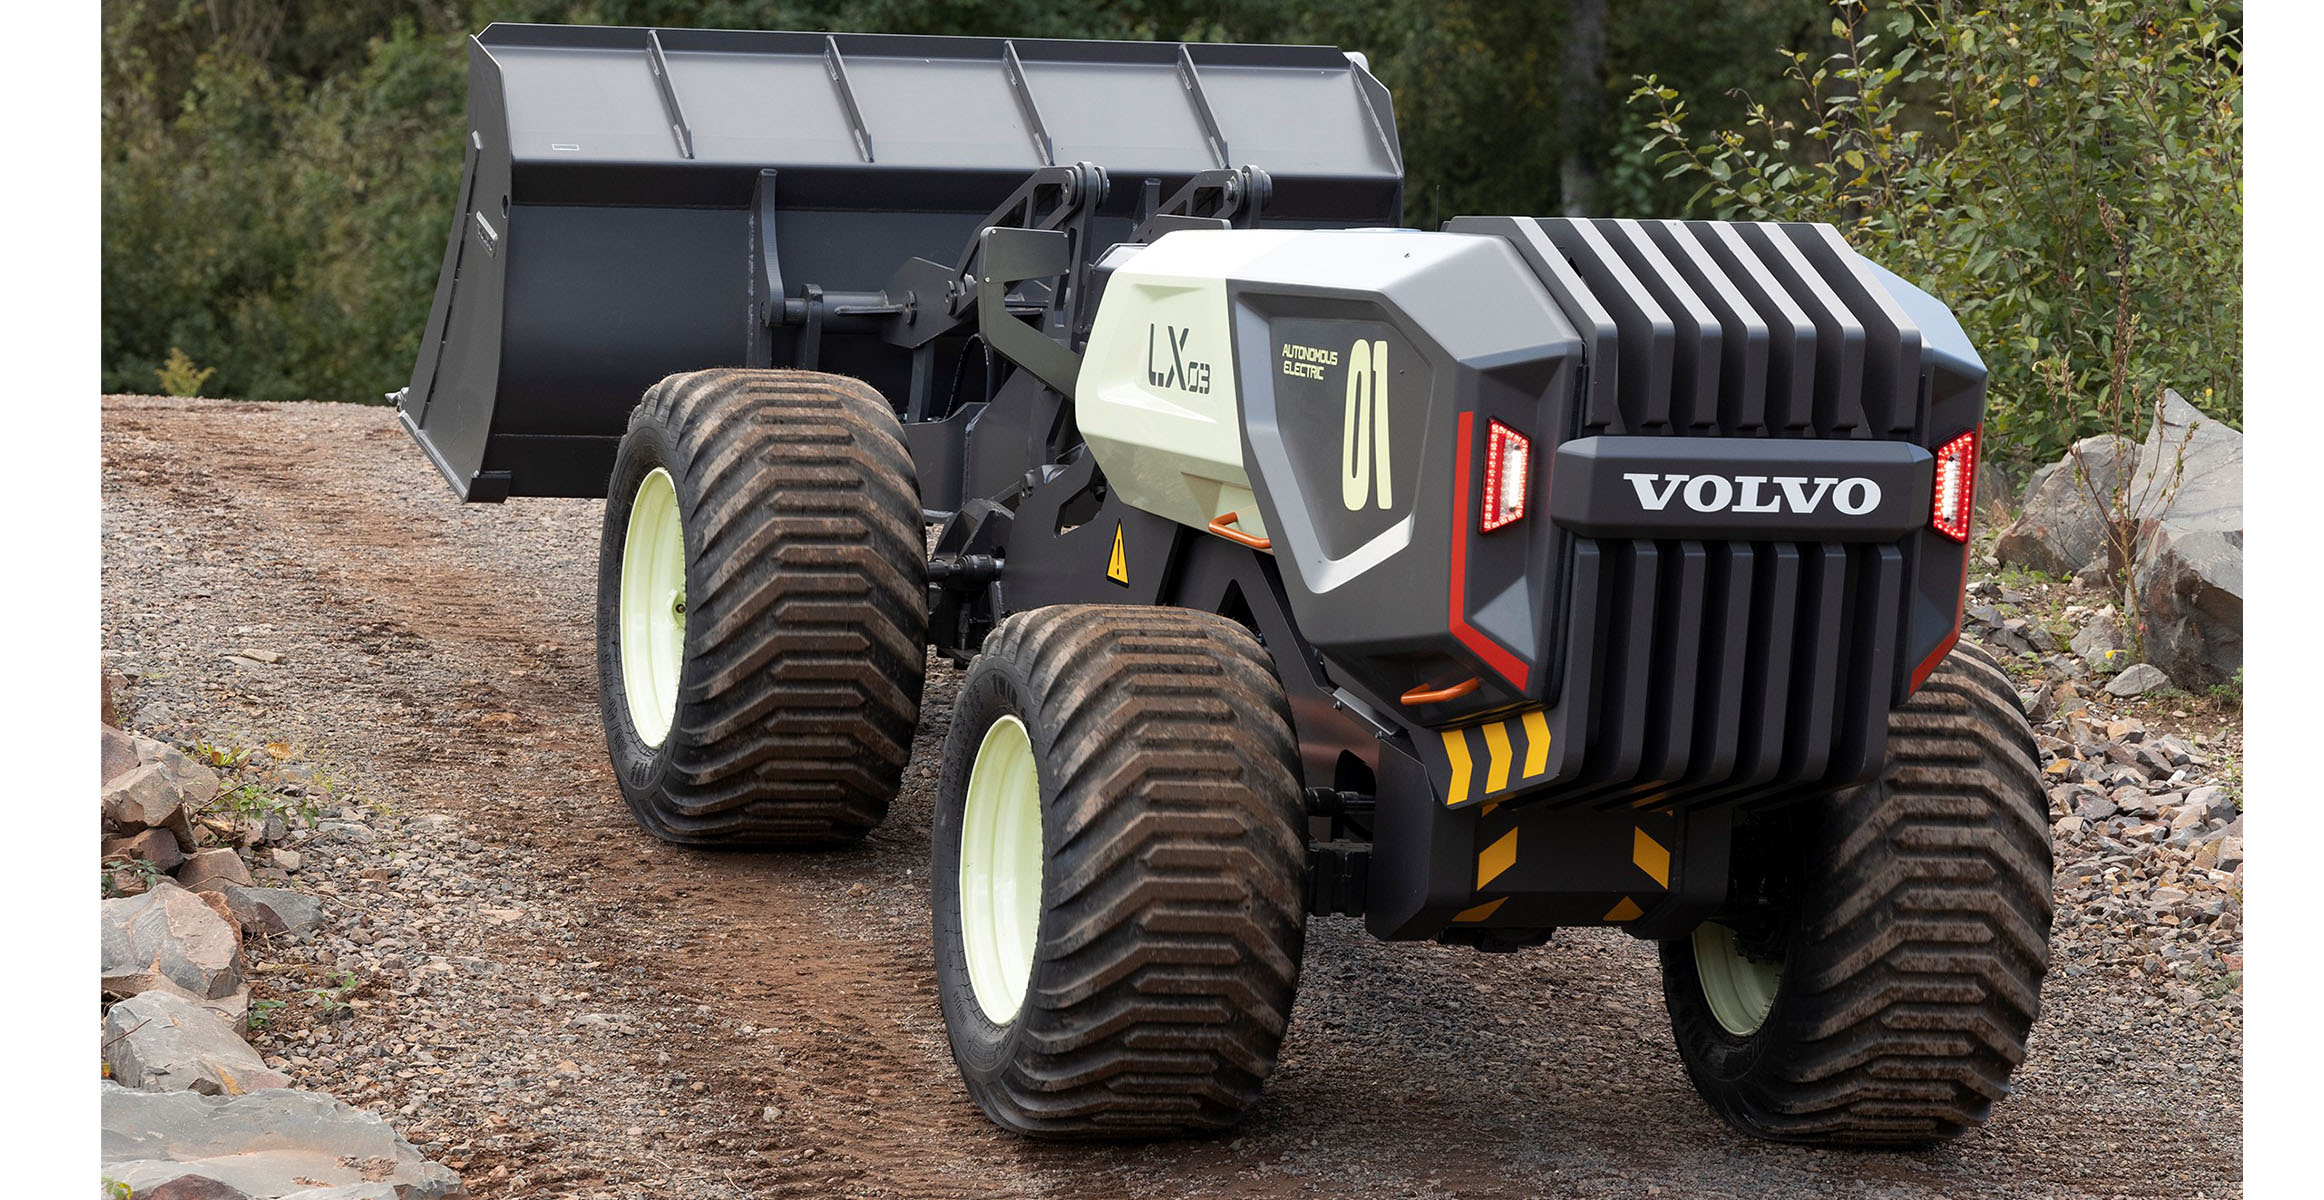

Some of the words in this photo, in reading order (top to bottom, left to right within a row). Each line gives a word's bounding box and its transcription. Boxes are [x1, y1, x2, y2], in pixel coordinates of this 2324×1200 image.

[1148, 323, 1211, 395] LX03
[1282, 344, 1339, 366] AUTONOMOUS
[1283, 361, 1325, 381] ELECTRIC
[1343, 339, 1392, 511] 01
[1624, 473, 1882, 516] VOLVO
